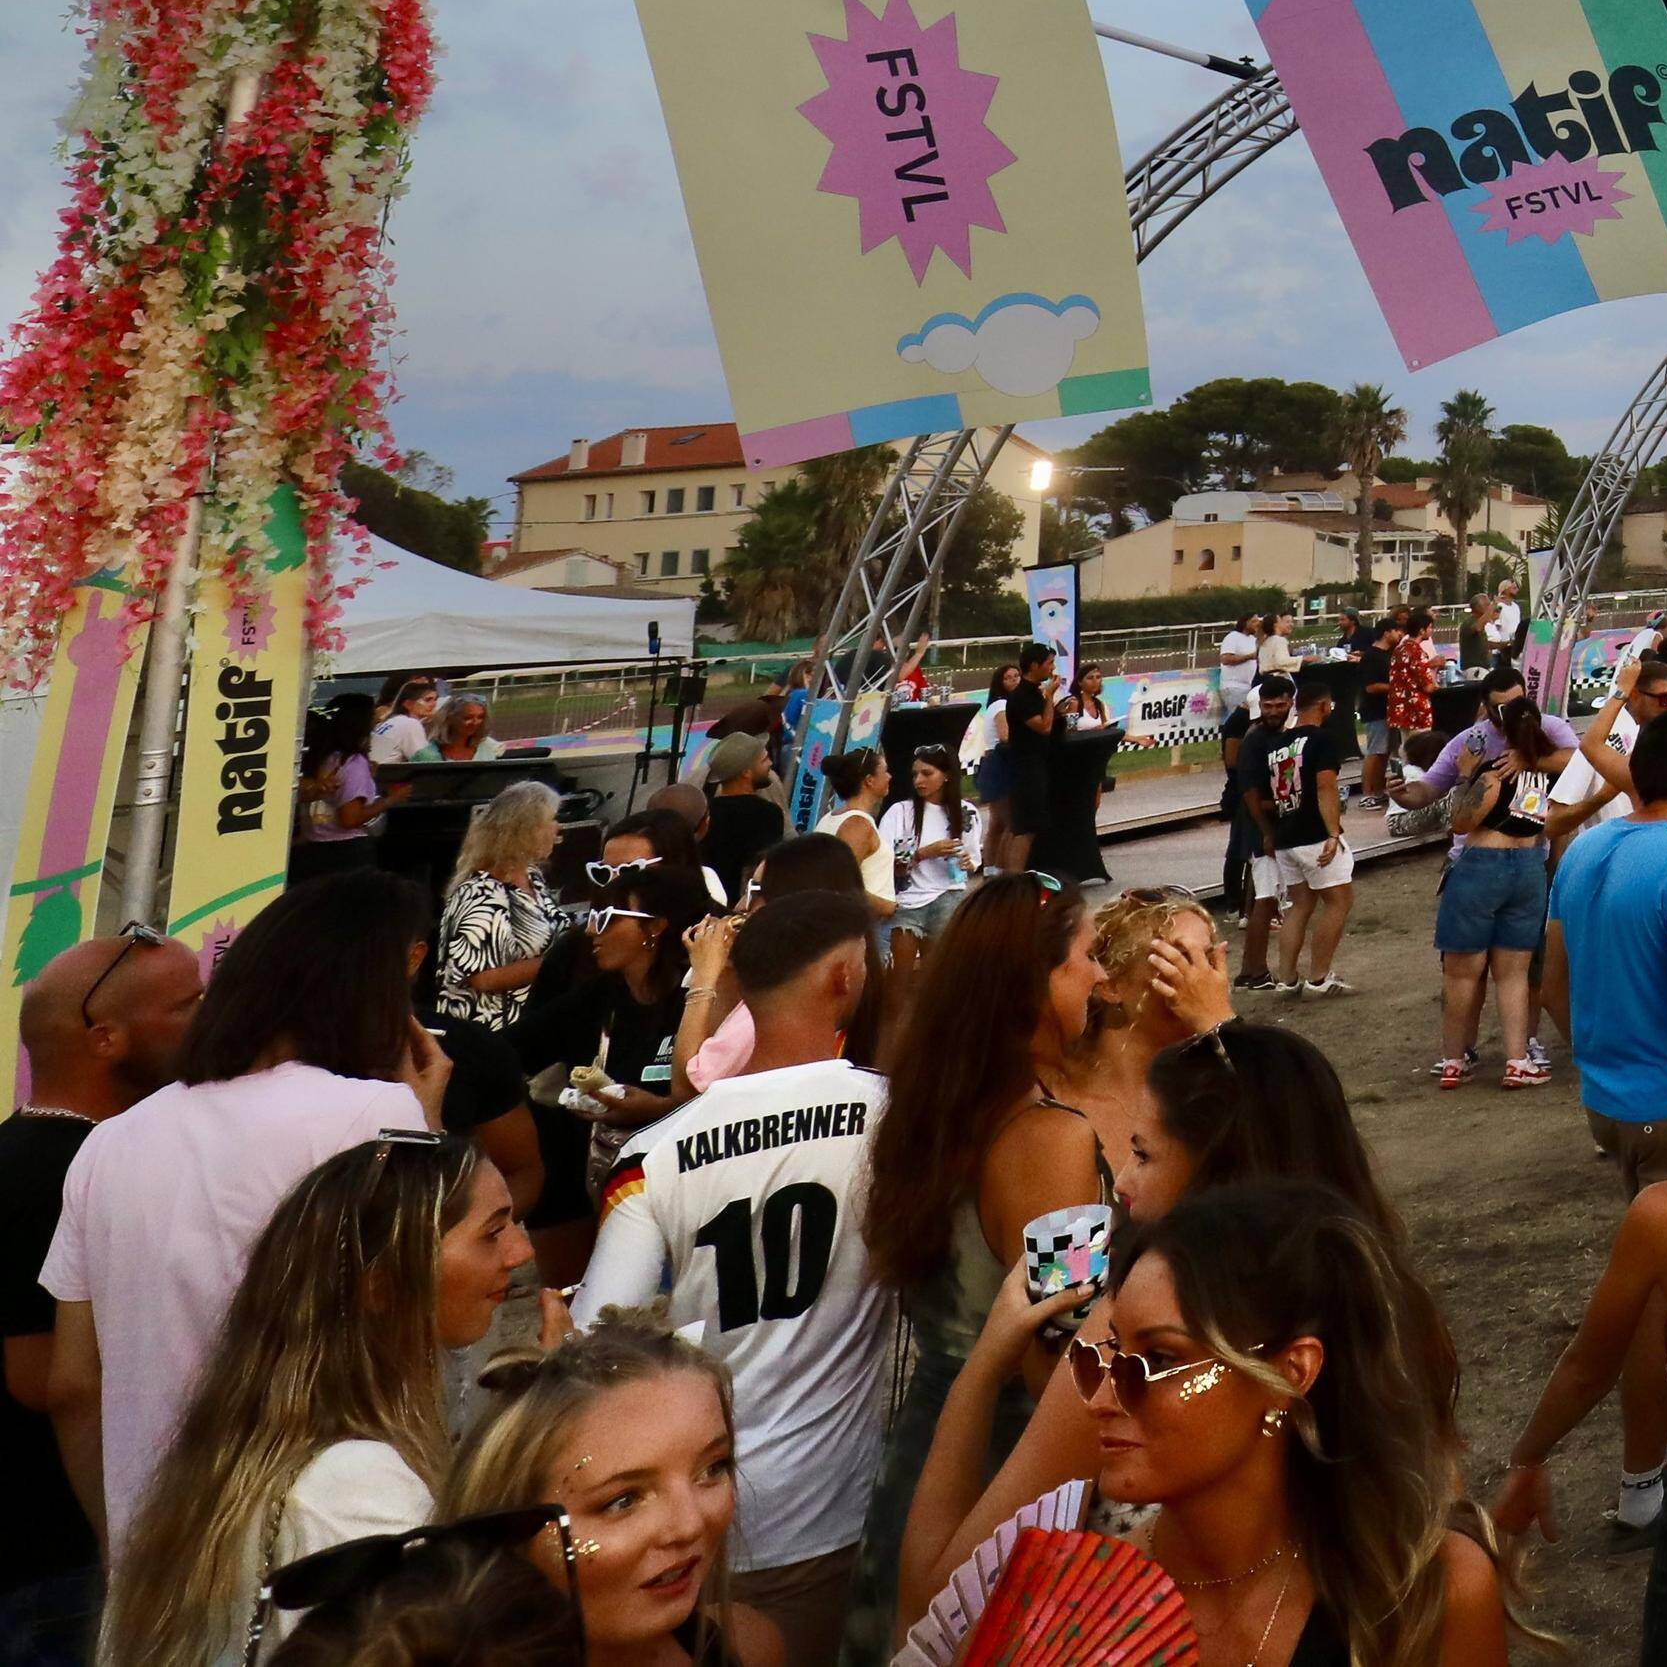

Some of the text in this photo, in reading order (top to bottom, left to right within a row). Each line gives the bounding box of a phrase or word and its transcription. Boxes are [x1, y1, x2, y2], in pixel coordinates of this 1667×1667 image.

[865, 47, 950, 224] FSTVL
[1363, 64, 1667, 215] natif
[1504, 180, 1603, 220] FSTVL
[215, 664, 273, 836] natif
[1141, 694, 1187, 720] natif
[212, 934, 230, 968] TVL
[676, 1102, 867, 1174] KALKBRENNER
[694, 1181, 838, 1333] 10
